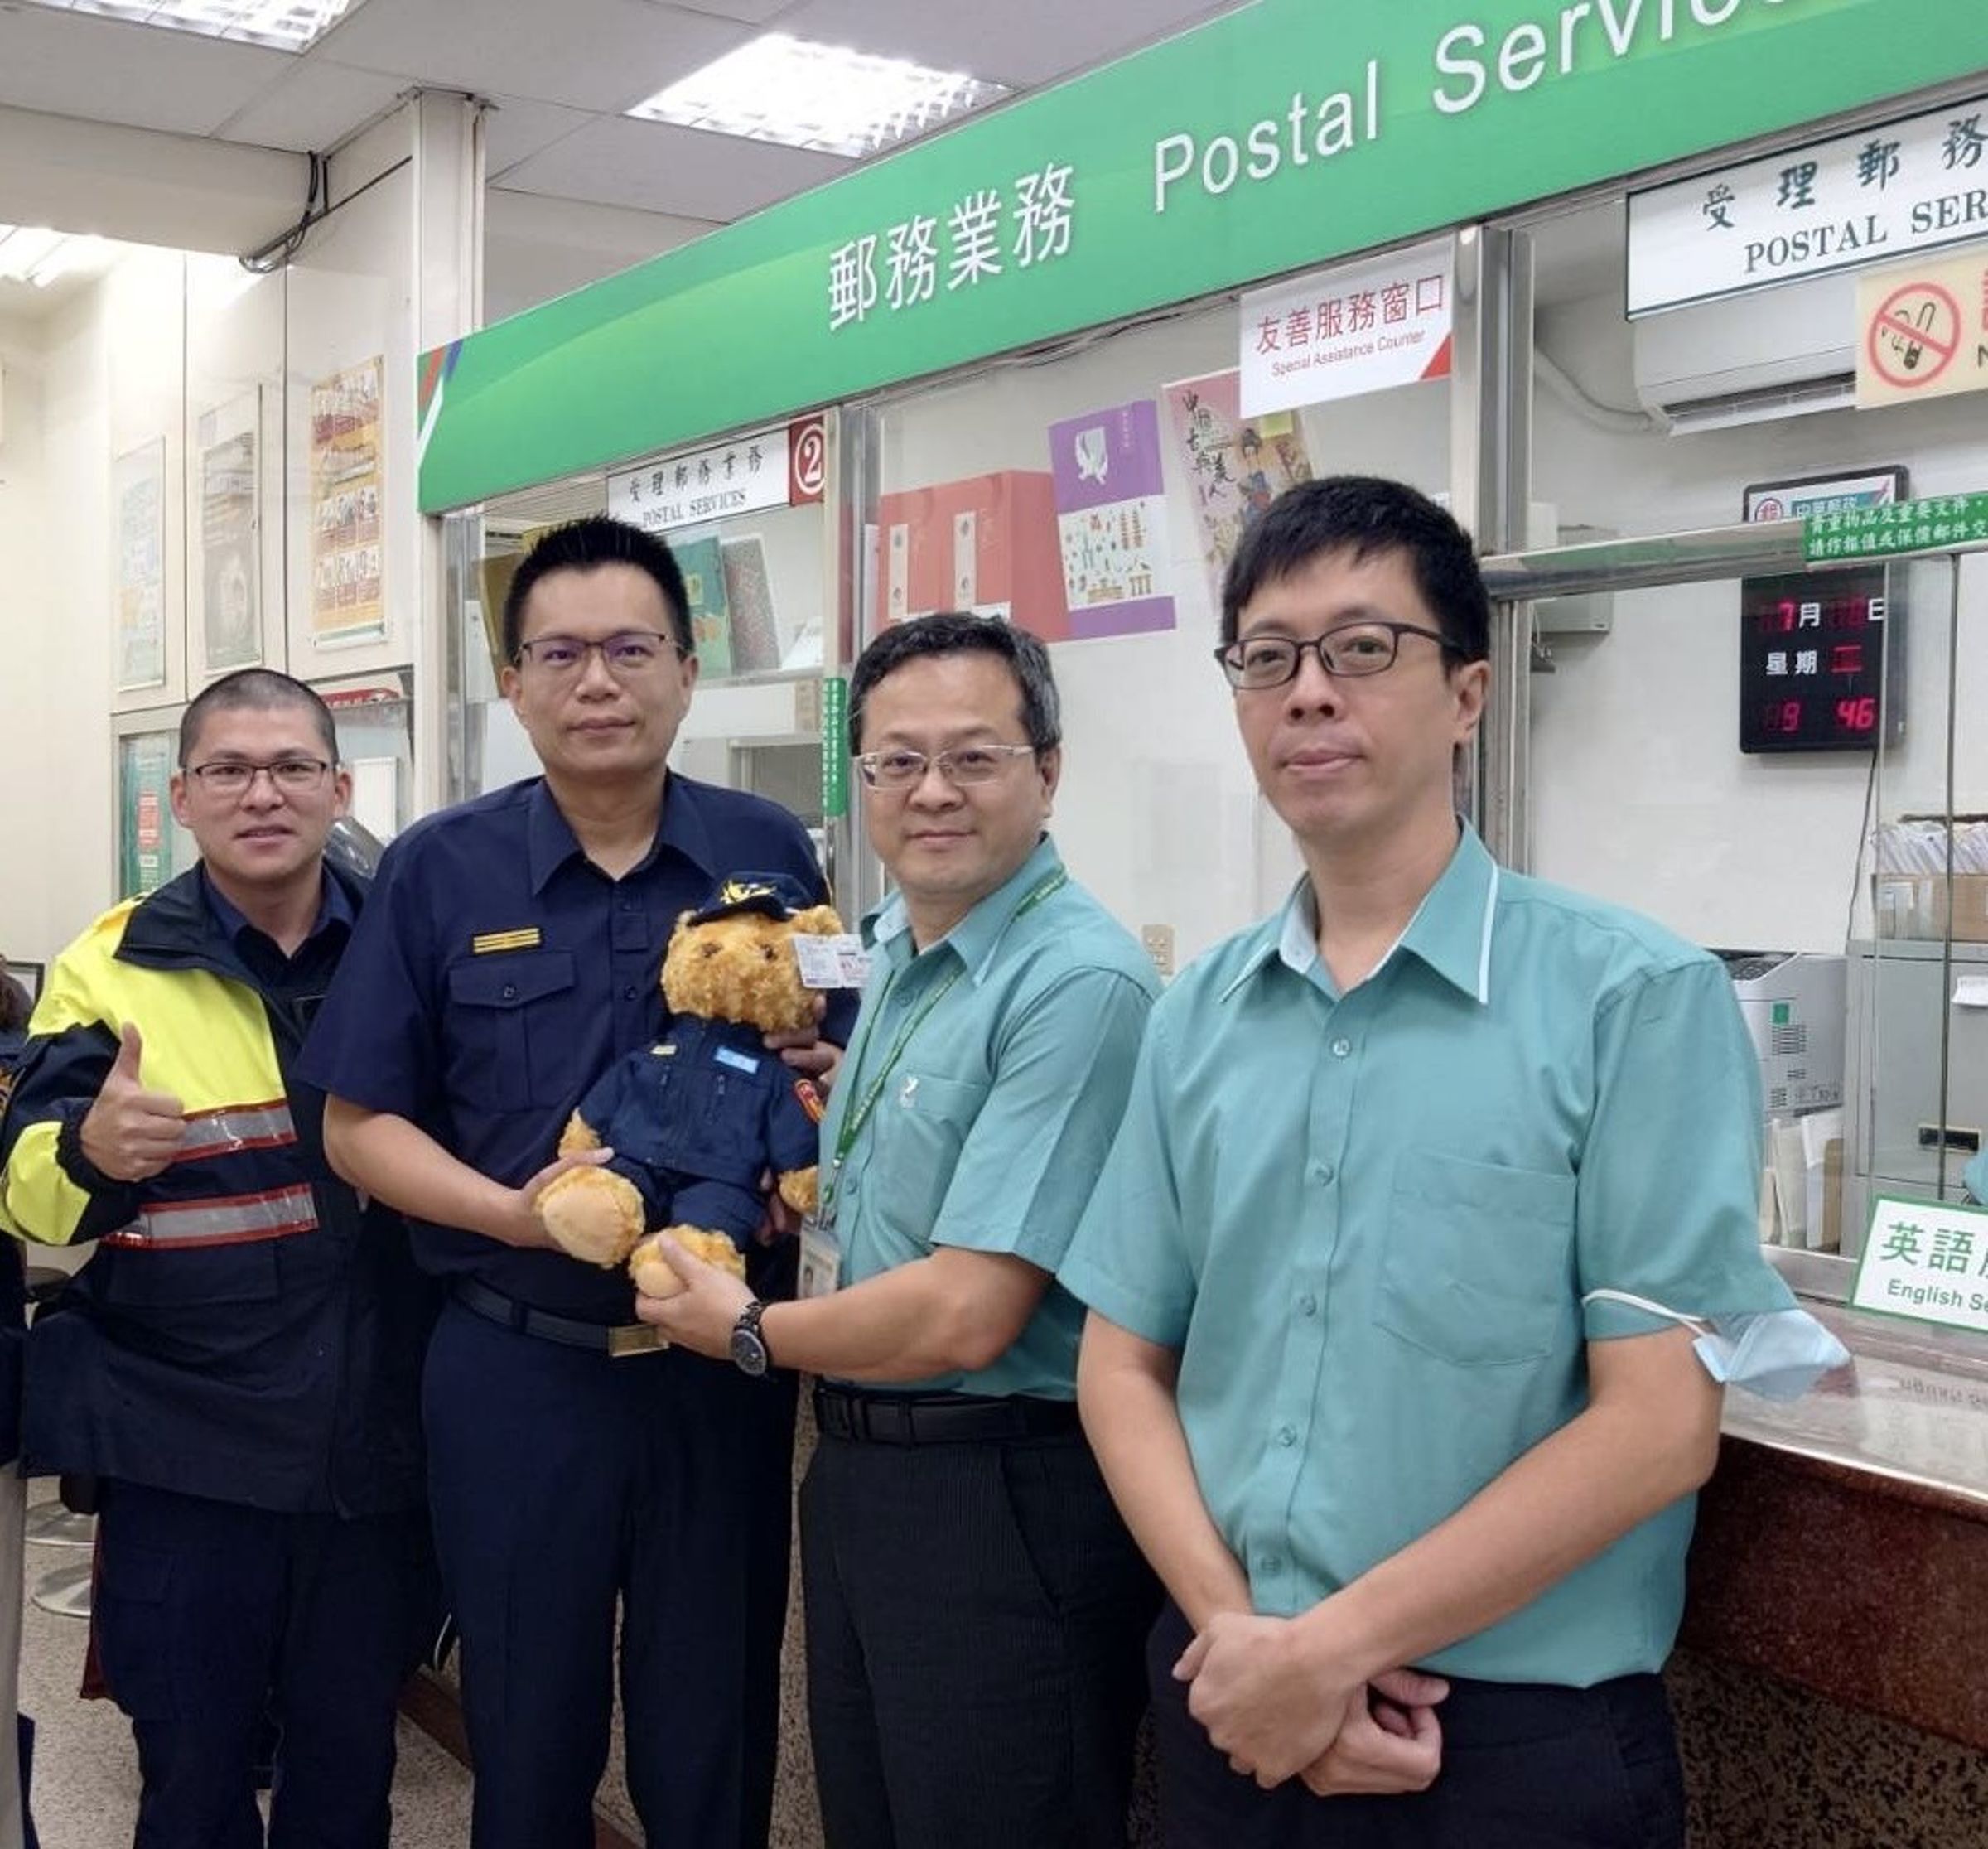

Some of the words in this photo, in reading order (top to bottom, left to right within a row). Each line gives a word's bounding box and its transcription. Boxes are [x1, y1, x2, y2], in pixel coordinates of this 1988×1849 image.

[1155, 61, 1378, 213] Postal
[1431, 0, 1788, 113] Servi
[1702, 113, 1988, 231] 受理郵務
[828, 162, 1075, 330] 郵務業務
[1744, 215, 1888, 273] POSTAL
[1257, 274, 1443, 355] 友善服務窗口
[1271, 356, 1310, 377] Special
[1313, 344, 1375, 366] Assistance
[1377, 330, 1426, 352] Counter
[803, 437, 822, 482] 2
[1837, 698, 1875, 729] 46
[1879, 1220, 1988, 1279] 英語
[1887, 1278, 1962, 1307] English
